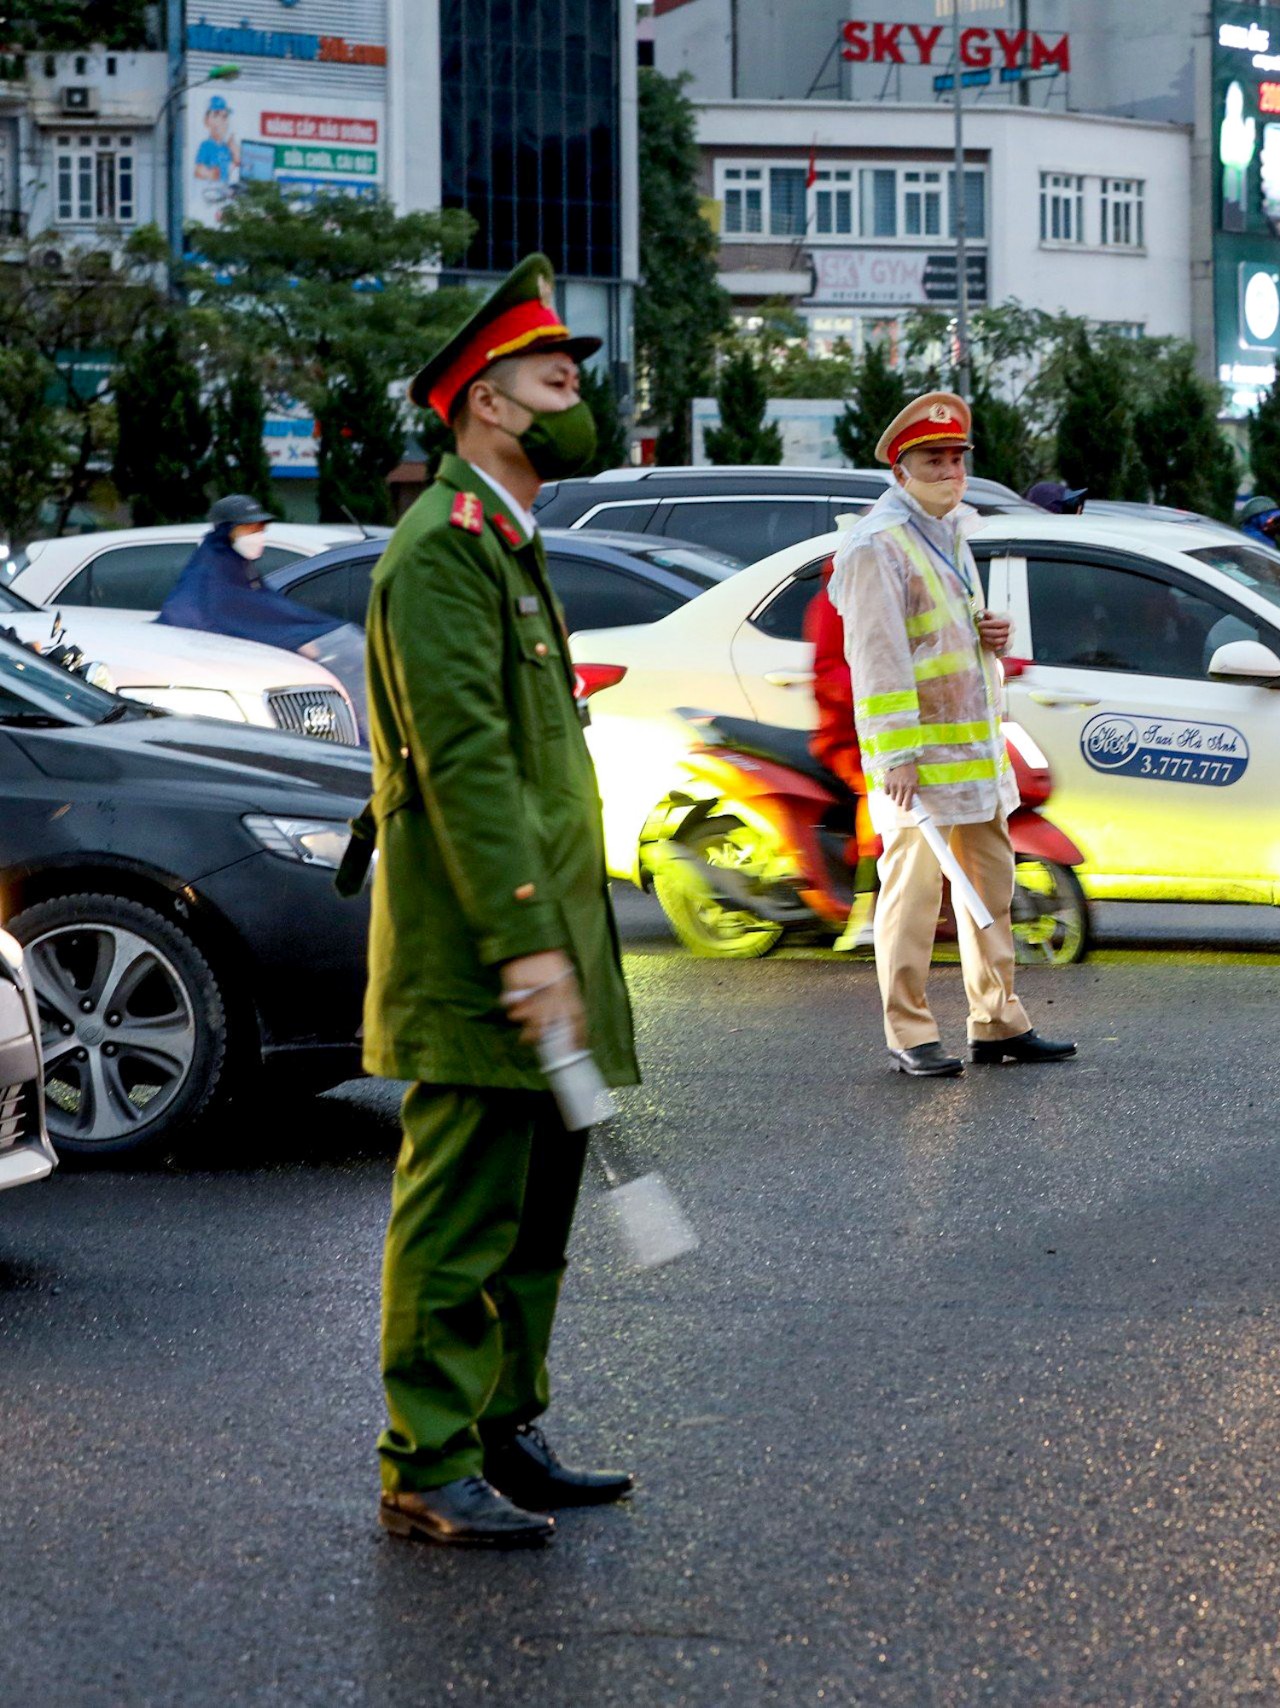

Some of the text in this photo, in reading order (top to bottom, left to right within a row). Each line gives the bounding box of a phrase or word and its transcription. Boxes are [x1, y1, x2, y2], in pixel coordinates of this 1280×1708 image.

[842, 20, 1070, 72] SKY GYM
[870, 258, 921, 285] GYM
[1142, 724, 1173, 746] Taxi
[1140, 755, 1233, 783] 3.777.777
